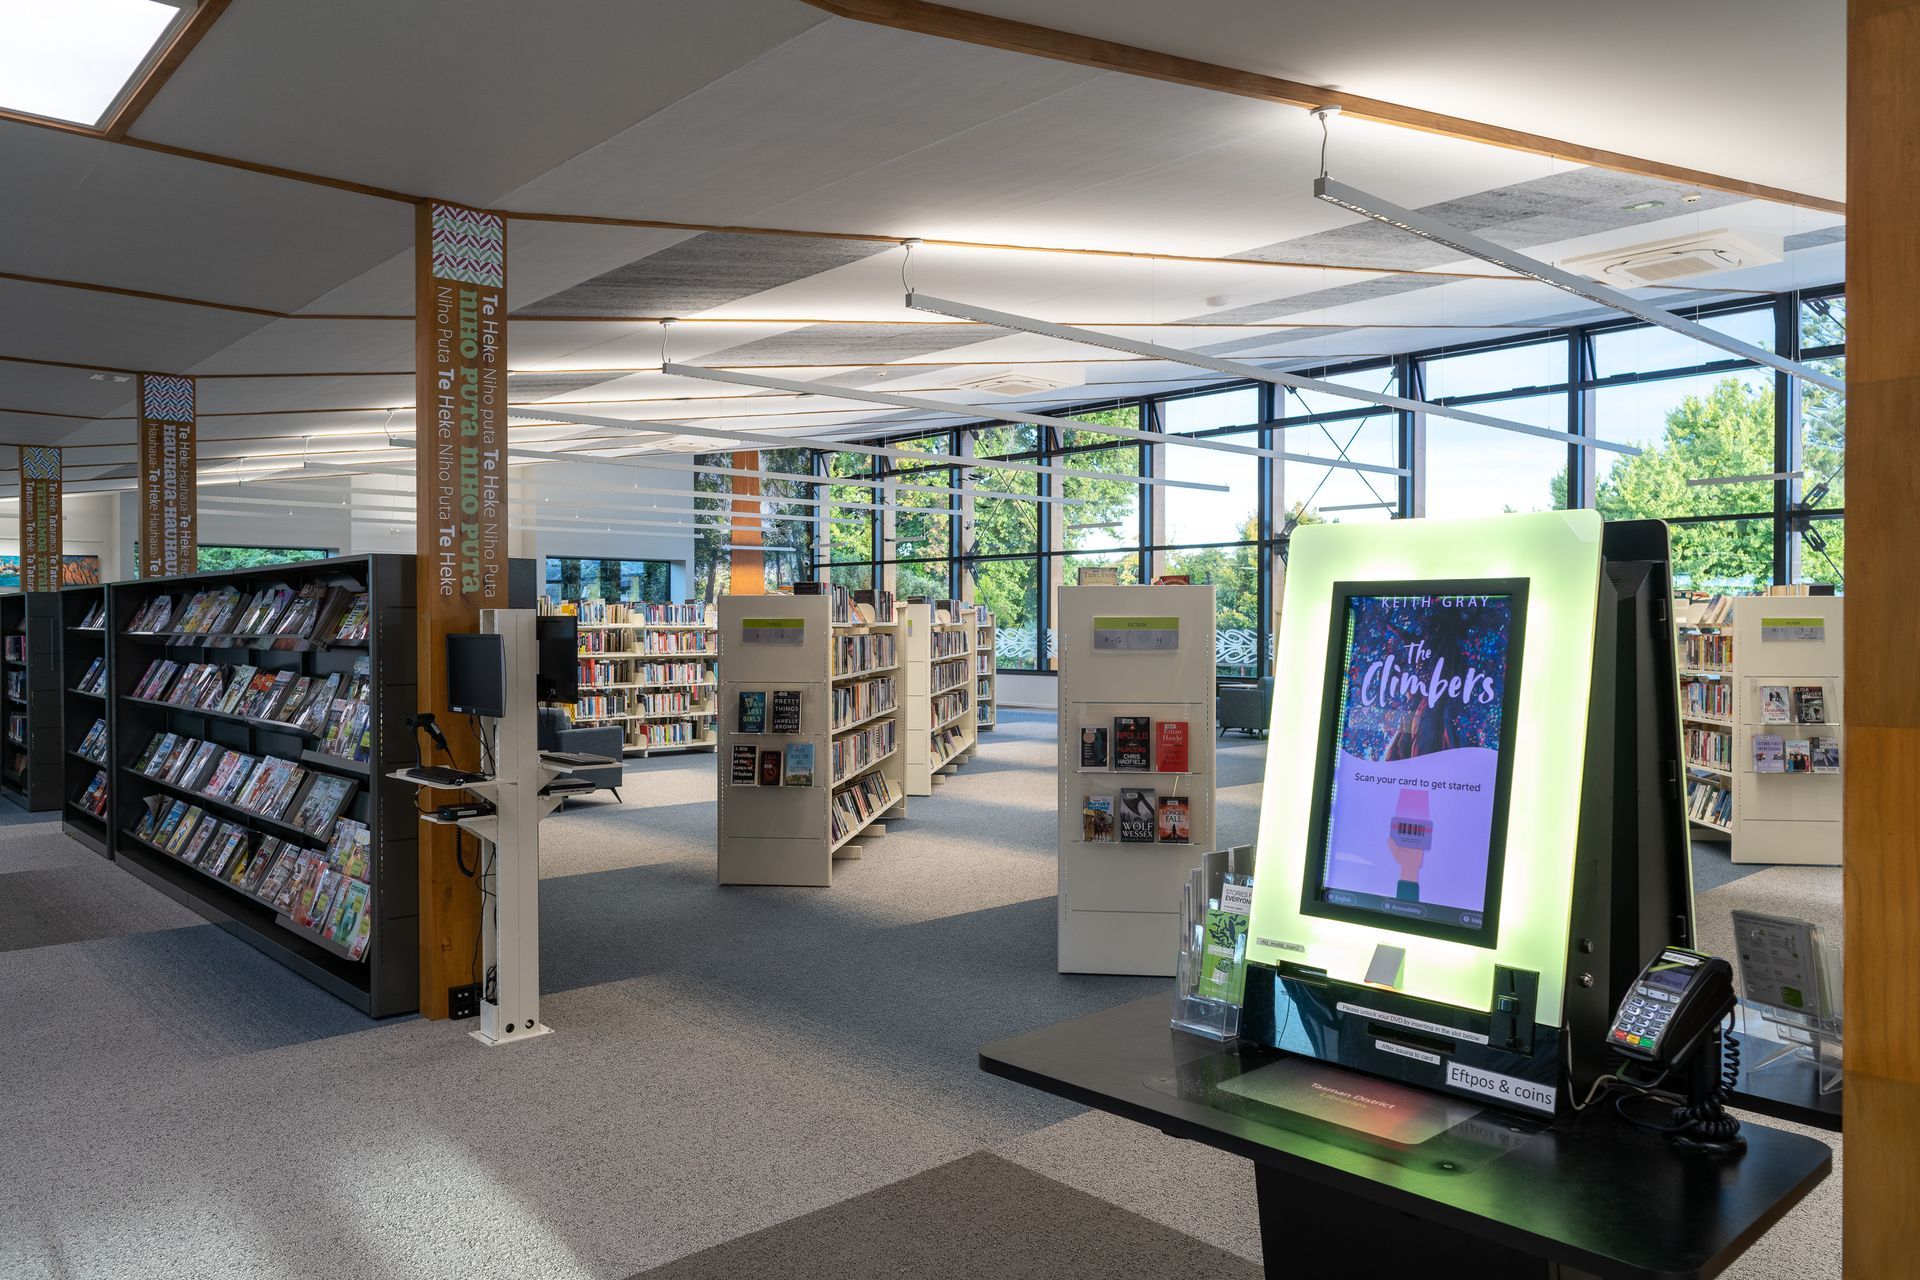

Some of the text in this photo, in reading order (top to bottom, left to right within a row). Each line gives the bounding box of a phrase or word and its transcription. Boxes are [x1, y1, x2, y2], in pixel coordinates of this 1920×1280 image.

[483, 295, 498, 316] Te
[482, 320, 499, 363] Heke
[483, 368, 499, 405] Niho
[179, 426, 191, 440] Te
[437, 286, 457, 596] Niho Puta Te Heke Niho Puta Te Heke
[179, 442, 191, 469] Heke
[483, 449, 499, 471] Te
[483, 475, 499, 518] Heke
[484, 523, 499, 560] Niho
[484, 564, 499, 598] Puta
[1381, 595, 1489, 608] KEITH GRAY
[1403, 639, 1431, 665] The
[1361, 654, 1495, 709] Climbers
[1354, 772, 1481, 792] Scan your card to get started
[1122, 821, 1153, 831] WOLF
[1122, 830, 1153, 838] WESSEX
[1225, 888, 1249, 898] STORIES
[1342, 1004, 1360, 1014] Please
[1360, 1008, 1377, 1017] unlock
[1377, 1012, 1390, 1021] your
[1390, 1015, 1403, 1024] DVD
[1403, 1018, 1411, 1026] by
[1411, 1020, 1434, 1032] inserting
[1441, 1027, 1451, 1035] the
[1451, 1029, 1462, 1038] slot
[1462, 1032, 1480, 1042] below
[1380, 1042, 1434, 1062] After issuing to card
[1311, 1082, 1396, 1109] Tasman District
[1451, 1067, 1552, 1105] Eftpos & coins
